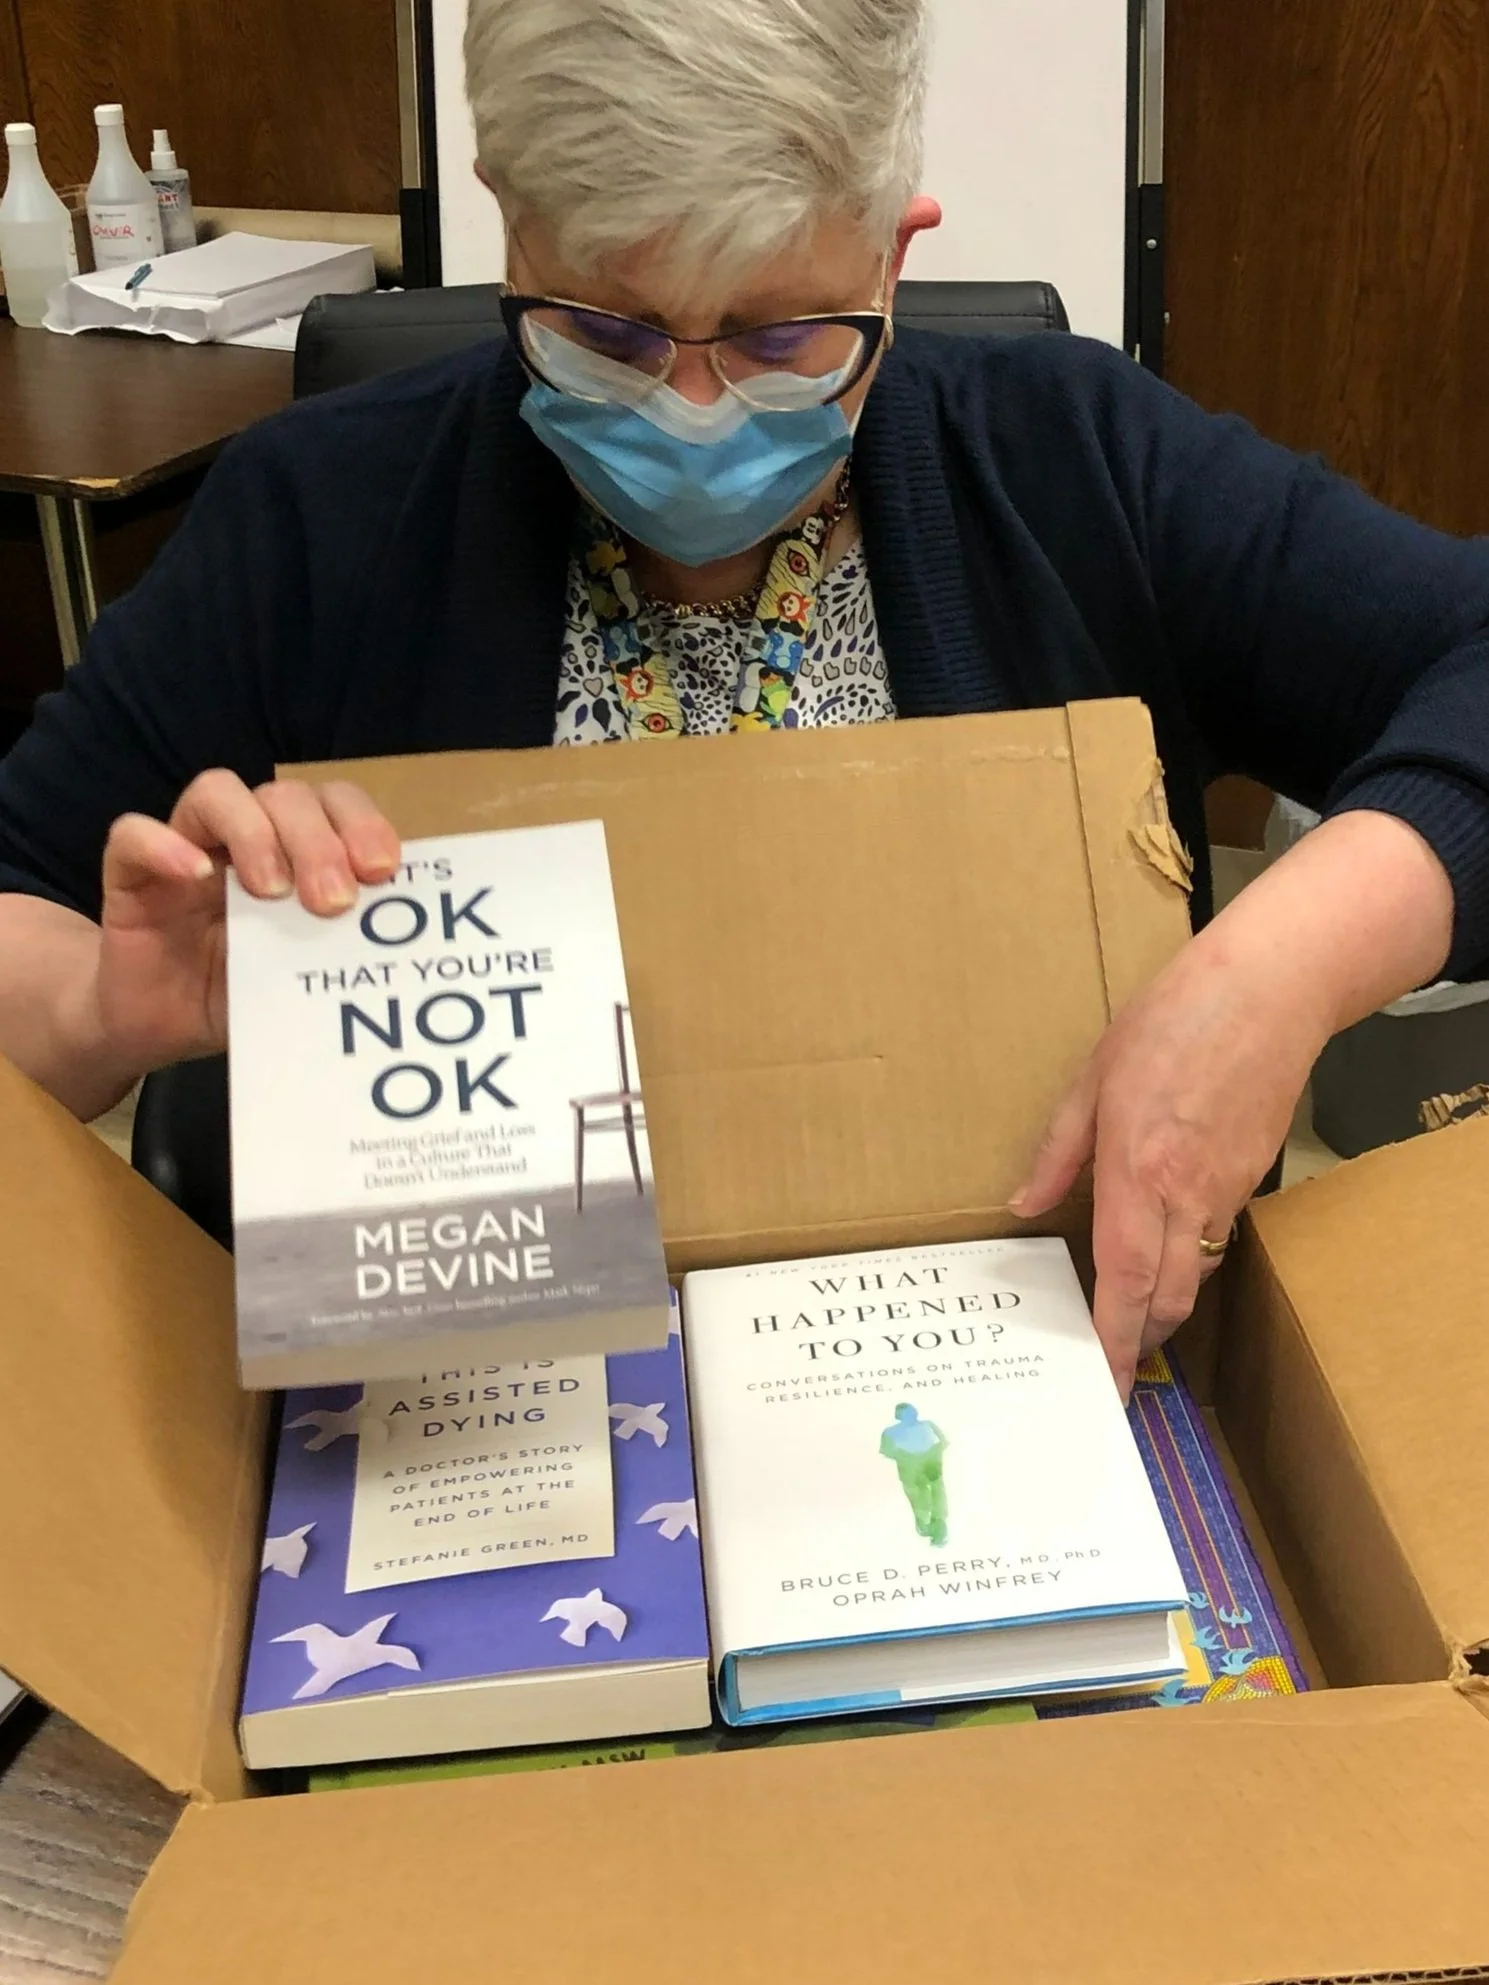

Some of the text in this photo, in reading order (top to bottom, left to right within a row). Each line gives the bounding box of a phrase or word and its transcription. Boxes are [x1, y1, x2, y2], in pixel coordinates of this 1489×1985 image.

[360, 885, 501, 946] OK
[297, 947, 554, 995] THAT YOU'RE
[340, 983, 543, 1055] NOT
[371, 1052, 519, 1121] OK
[421, 1125, 463, 1148] Grief
[464, 1124, 496, 1142] and
[477, 1142, 513, 1159] That
[355, 1202, 546, 1259] MEGAN
[356, 1243, 554, 1301] DEVINE
[808, 1266, 949, 1296] WHAT
[751, 1290, 1022, 1335] HAPPENED
[798, 1323, 1005, 1361] TO YOU?
[746, 1365, 916, 1392] CONVERSATIONS
[927, 1362, 953, 1373] ON
[765, 1369, 1041, 1404] RESILIENCE, AND HEALING
[388, 1378, 580, 1417] ASSISTED
[423, 1407, 546, 1438] DYING
[383, 1444, 584, 1480] A DOCTOR'S STORY
[392, 1462, 574, 1495] OF EMPOWERING
[390, 1479, 575, 1513] PATIENTS AT THE
[414, 1500, 551, 1528] END OF LIFE
[374, 1533, 590, 1571] STEFANIE GREEN, MD
[781, 1570, 870, 1593] BRUCE
[883, 1567, 906, 1581] D.
[917, 1556, 1011, 1578] PERRY,
[1064, 1549, 1101, 1560] PhD
[832, 1569, 1062, 1607] OPRAH WINFREY
